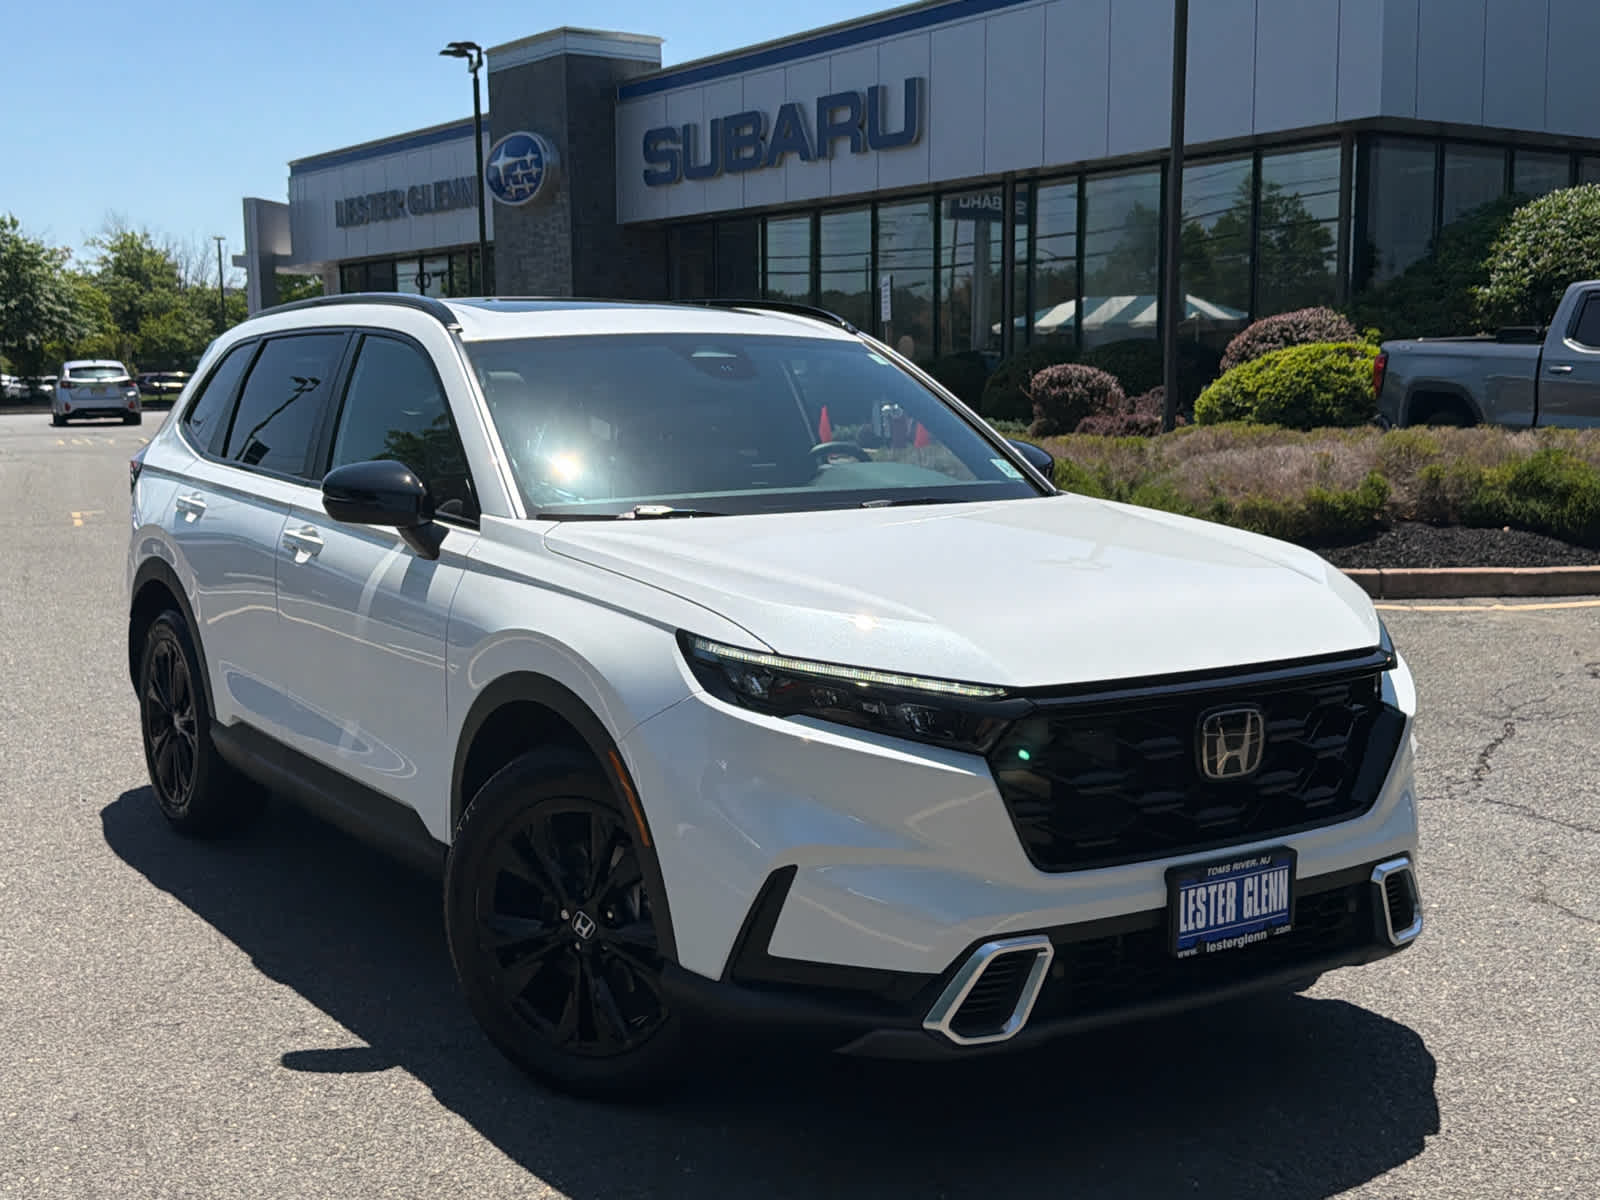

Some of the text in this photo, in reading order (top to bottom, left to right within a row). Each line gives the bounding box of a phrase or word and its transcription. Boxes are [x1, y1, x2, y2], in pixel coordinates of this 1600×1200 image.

[643, 77, 922, 187] SUBARU
[336, 176, 479, 228] LESTER GLENN
[1207, 864, 1231, 877] TOMS
[1260, 855, 1272, 865] NJ
[1179, 869, 1289, 932] LESTER GLENN
[1206, 932, 1267, 953] lesterglenn
